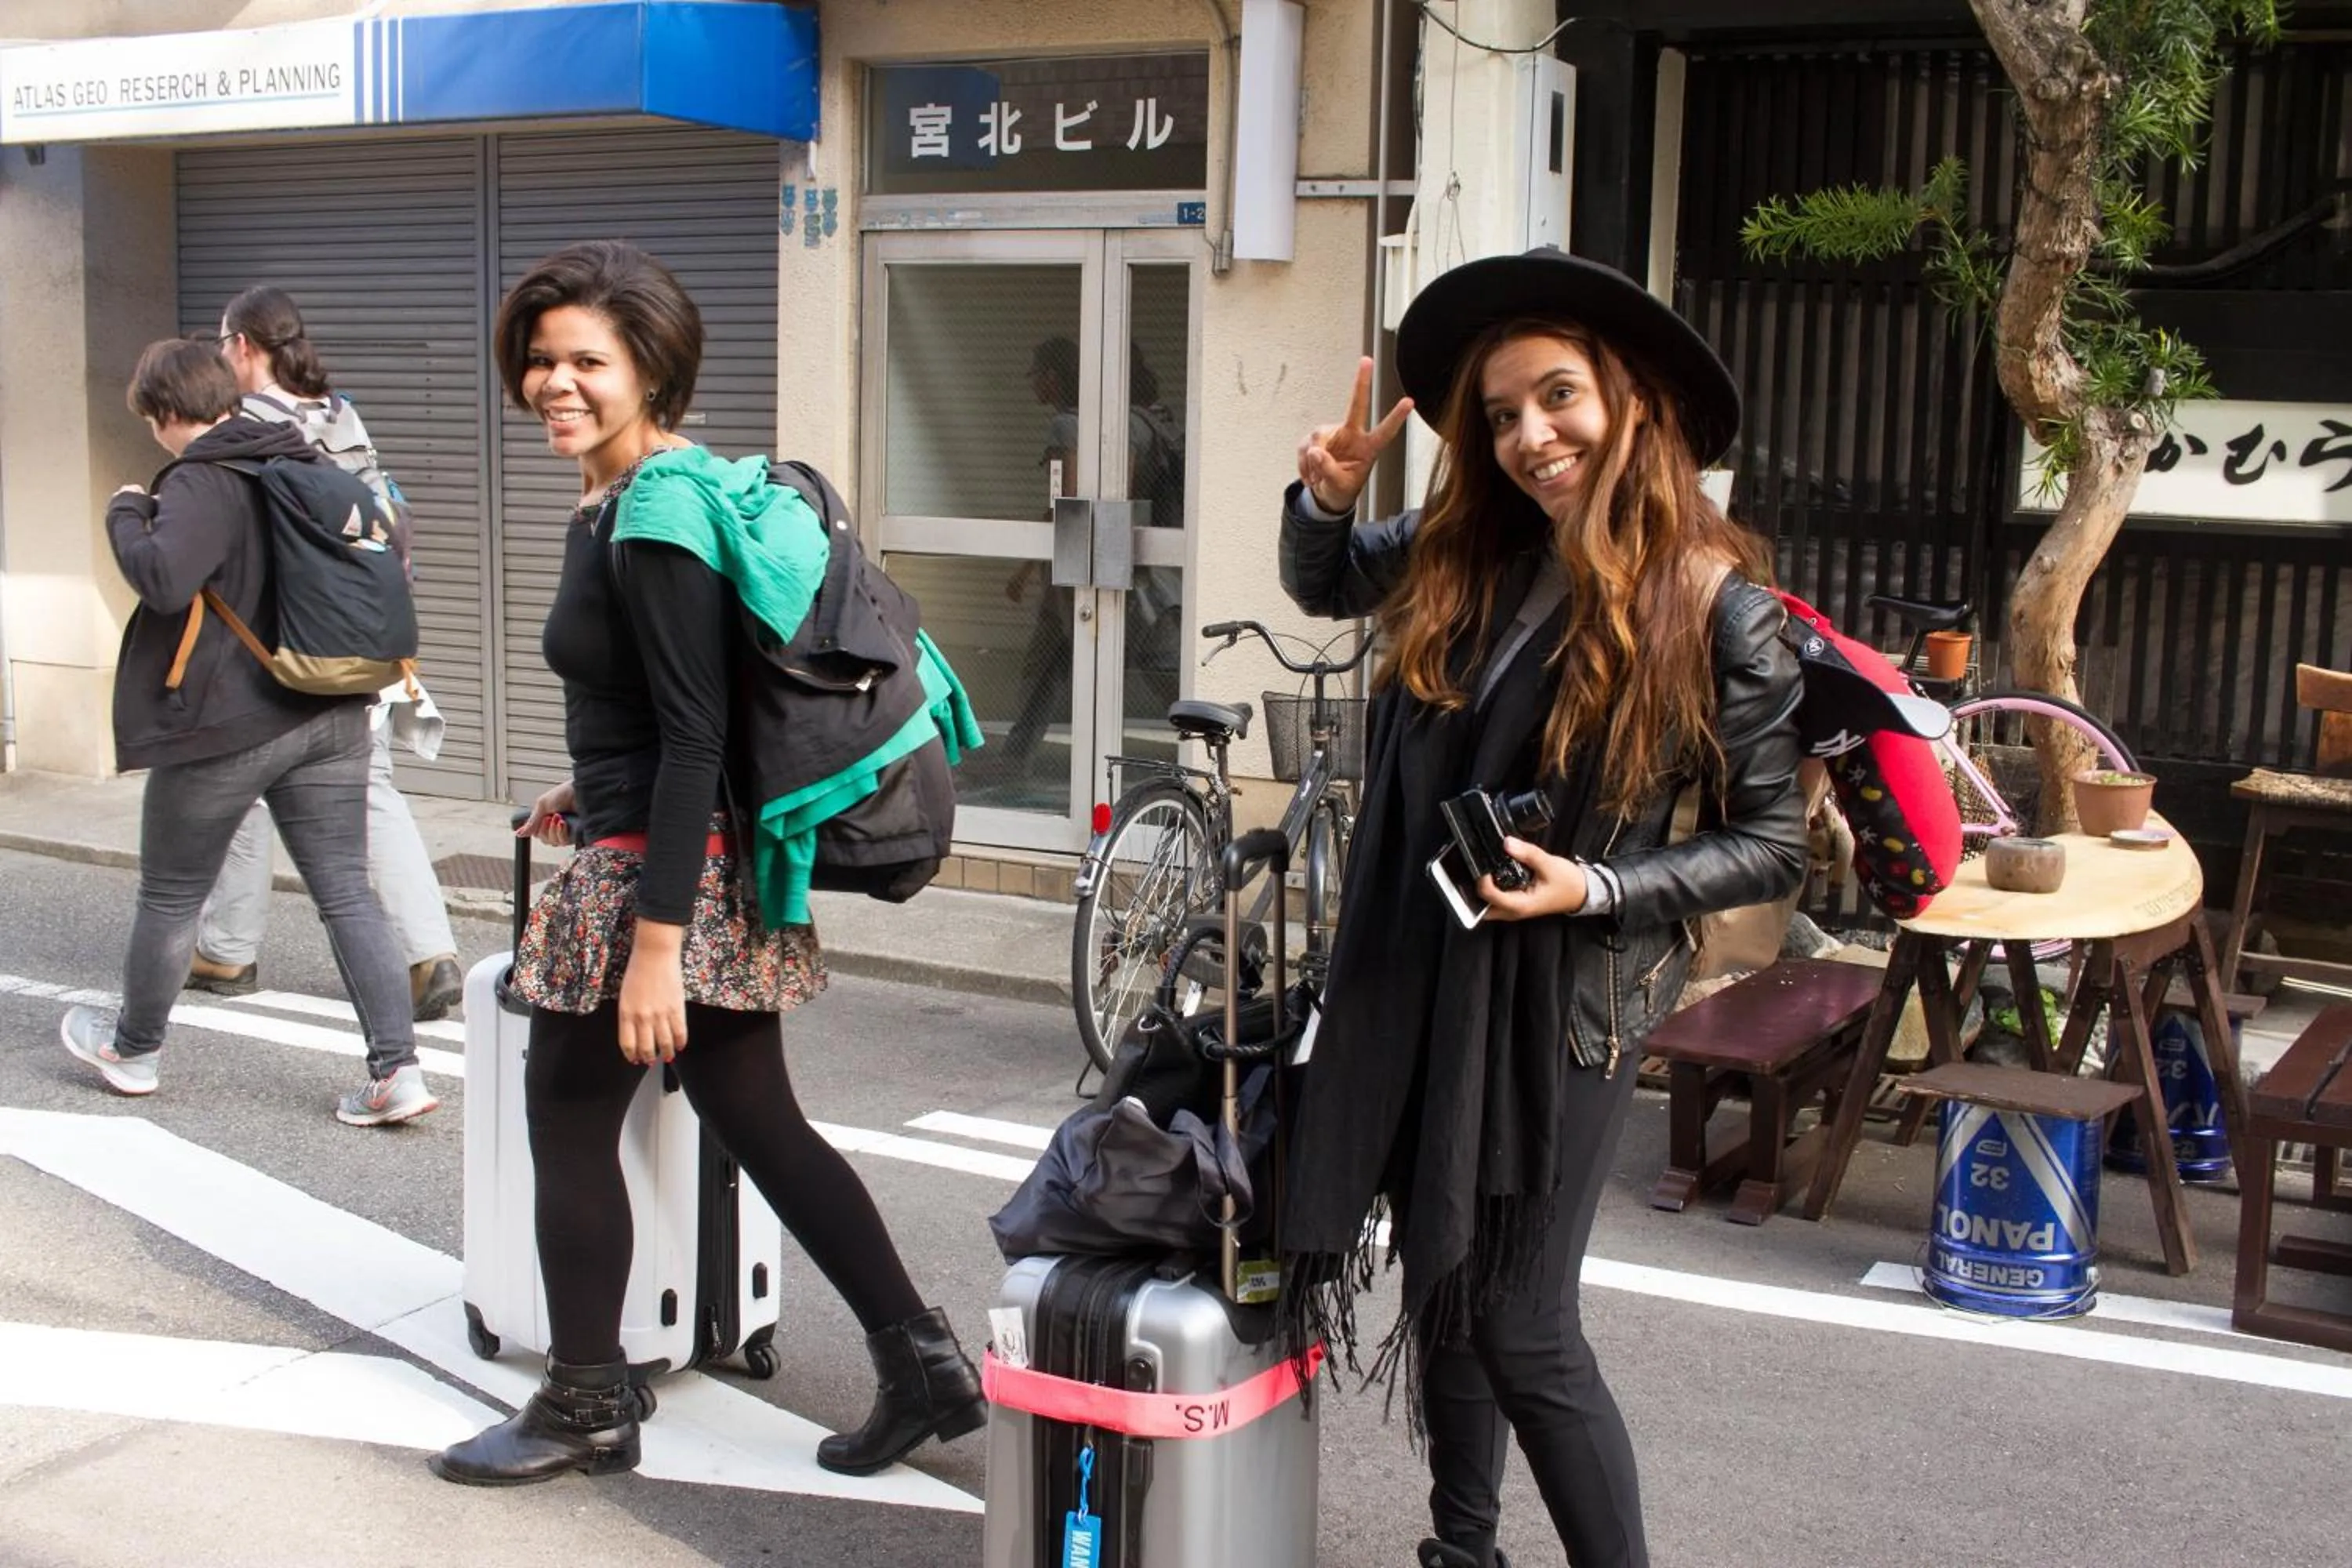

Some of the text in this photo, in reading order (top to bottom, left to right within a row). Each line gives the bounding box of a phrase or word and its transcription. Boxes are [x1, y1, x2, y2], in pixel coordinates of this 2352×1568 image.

[13, 63, 340, 111] ATLAS GEO RESERCH & PLANNING
[909, 98, 1174, 158] 宮北ビル
[1970, 1162, 2009, 1190] 32
[1937, 1202, 2055, 1251] PANOL
[1937, 1250, 2045, 1289] GENERAL
